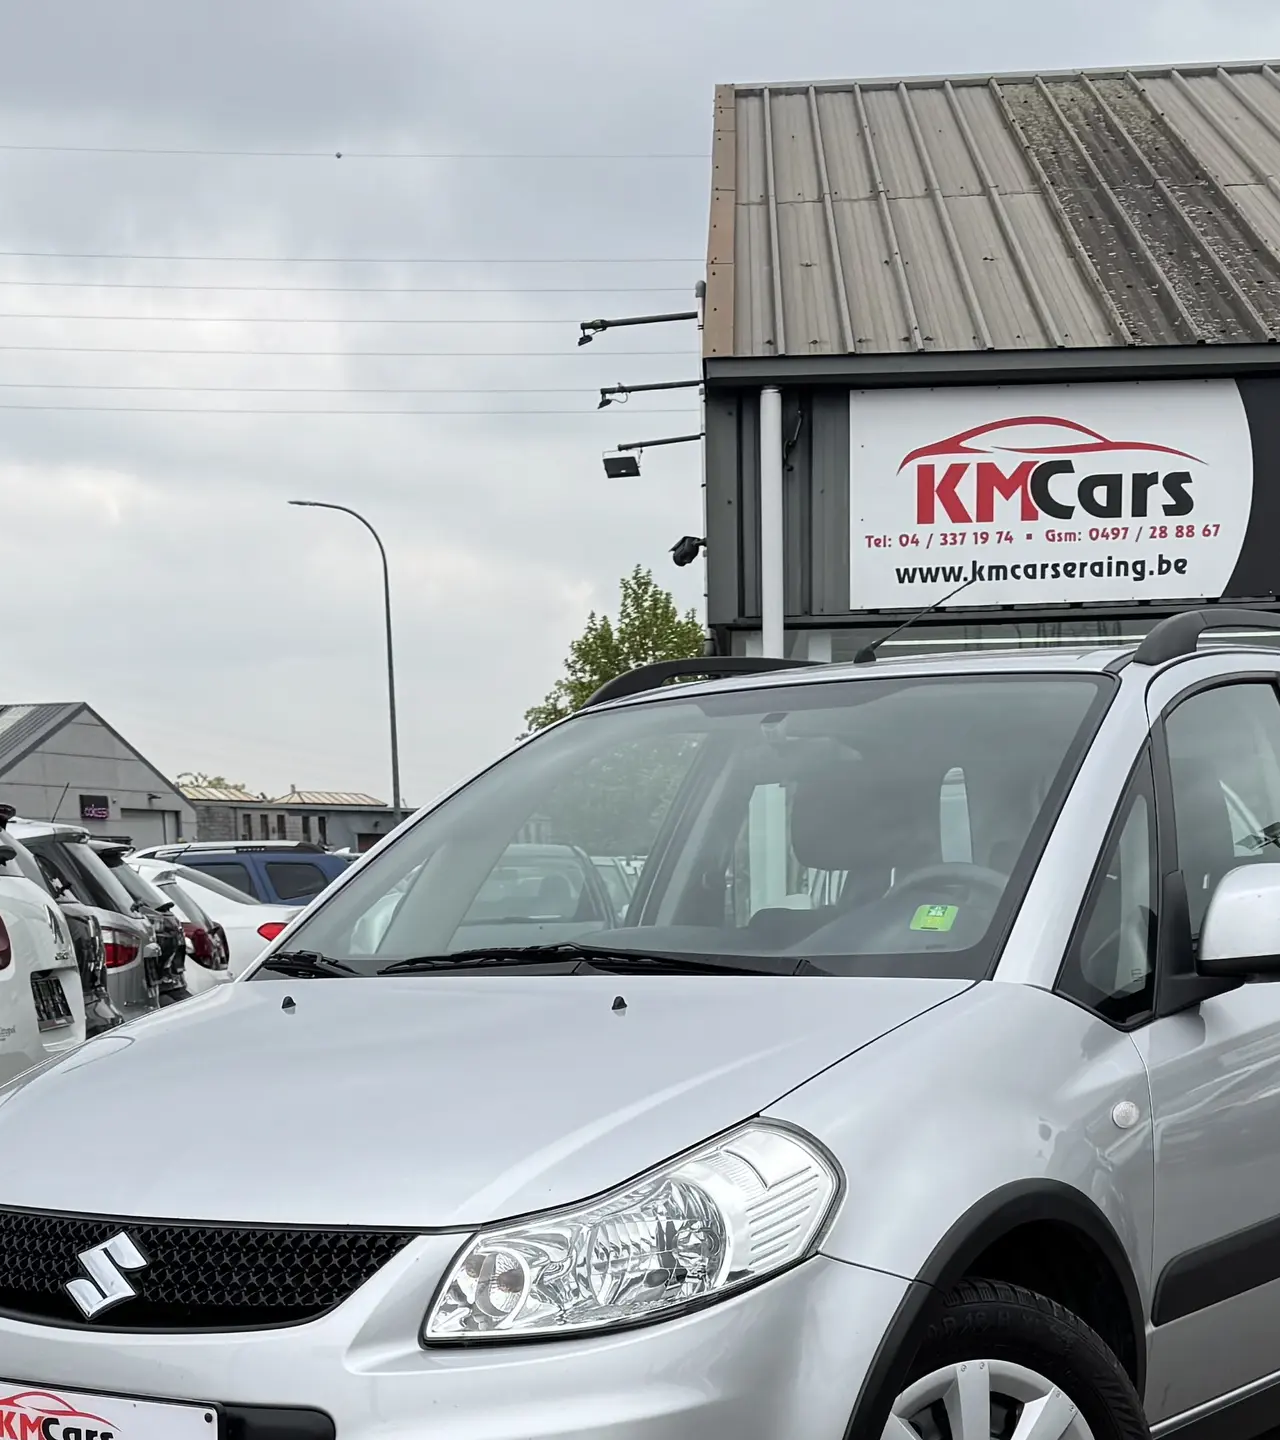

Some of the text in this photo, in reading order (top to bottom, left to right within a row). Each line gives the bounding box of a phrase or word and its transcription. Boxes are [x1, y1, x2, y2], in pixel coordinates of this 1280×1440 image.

[916, 459, 1194, 526] KMCars
[864, 534, 892, 549] Tel:
[898, 533, 920, 548] 04
[939, 532, 967, 546] 337
[972, 531, 989, 545] 19
[995, 530, 1014, 544] 74
[1045, 529, 1082, 543] Gsm:
[1088, 526, 1129, 541] 0497
[1149, 525, 1168, 539] 28
[1175, 524, 1195, 538] 88
[1202, 524, 1221, 537] 67
[895, 553, 1188, 584] www.kmcarseraing.be
